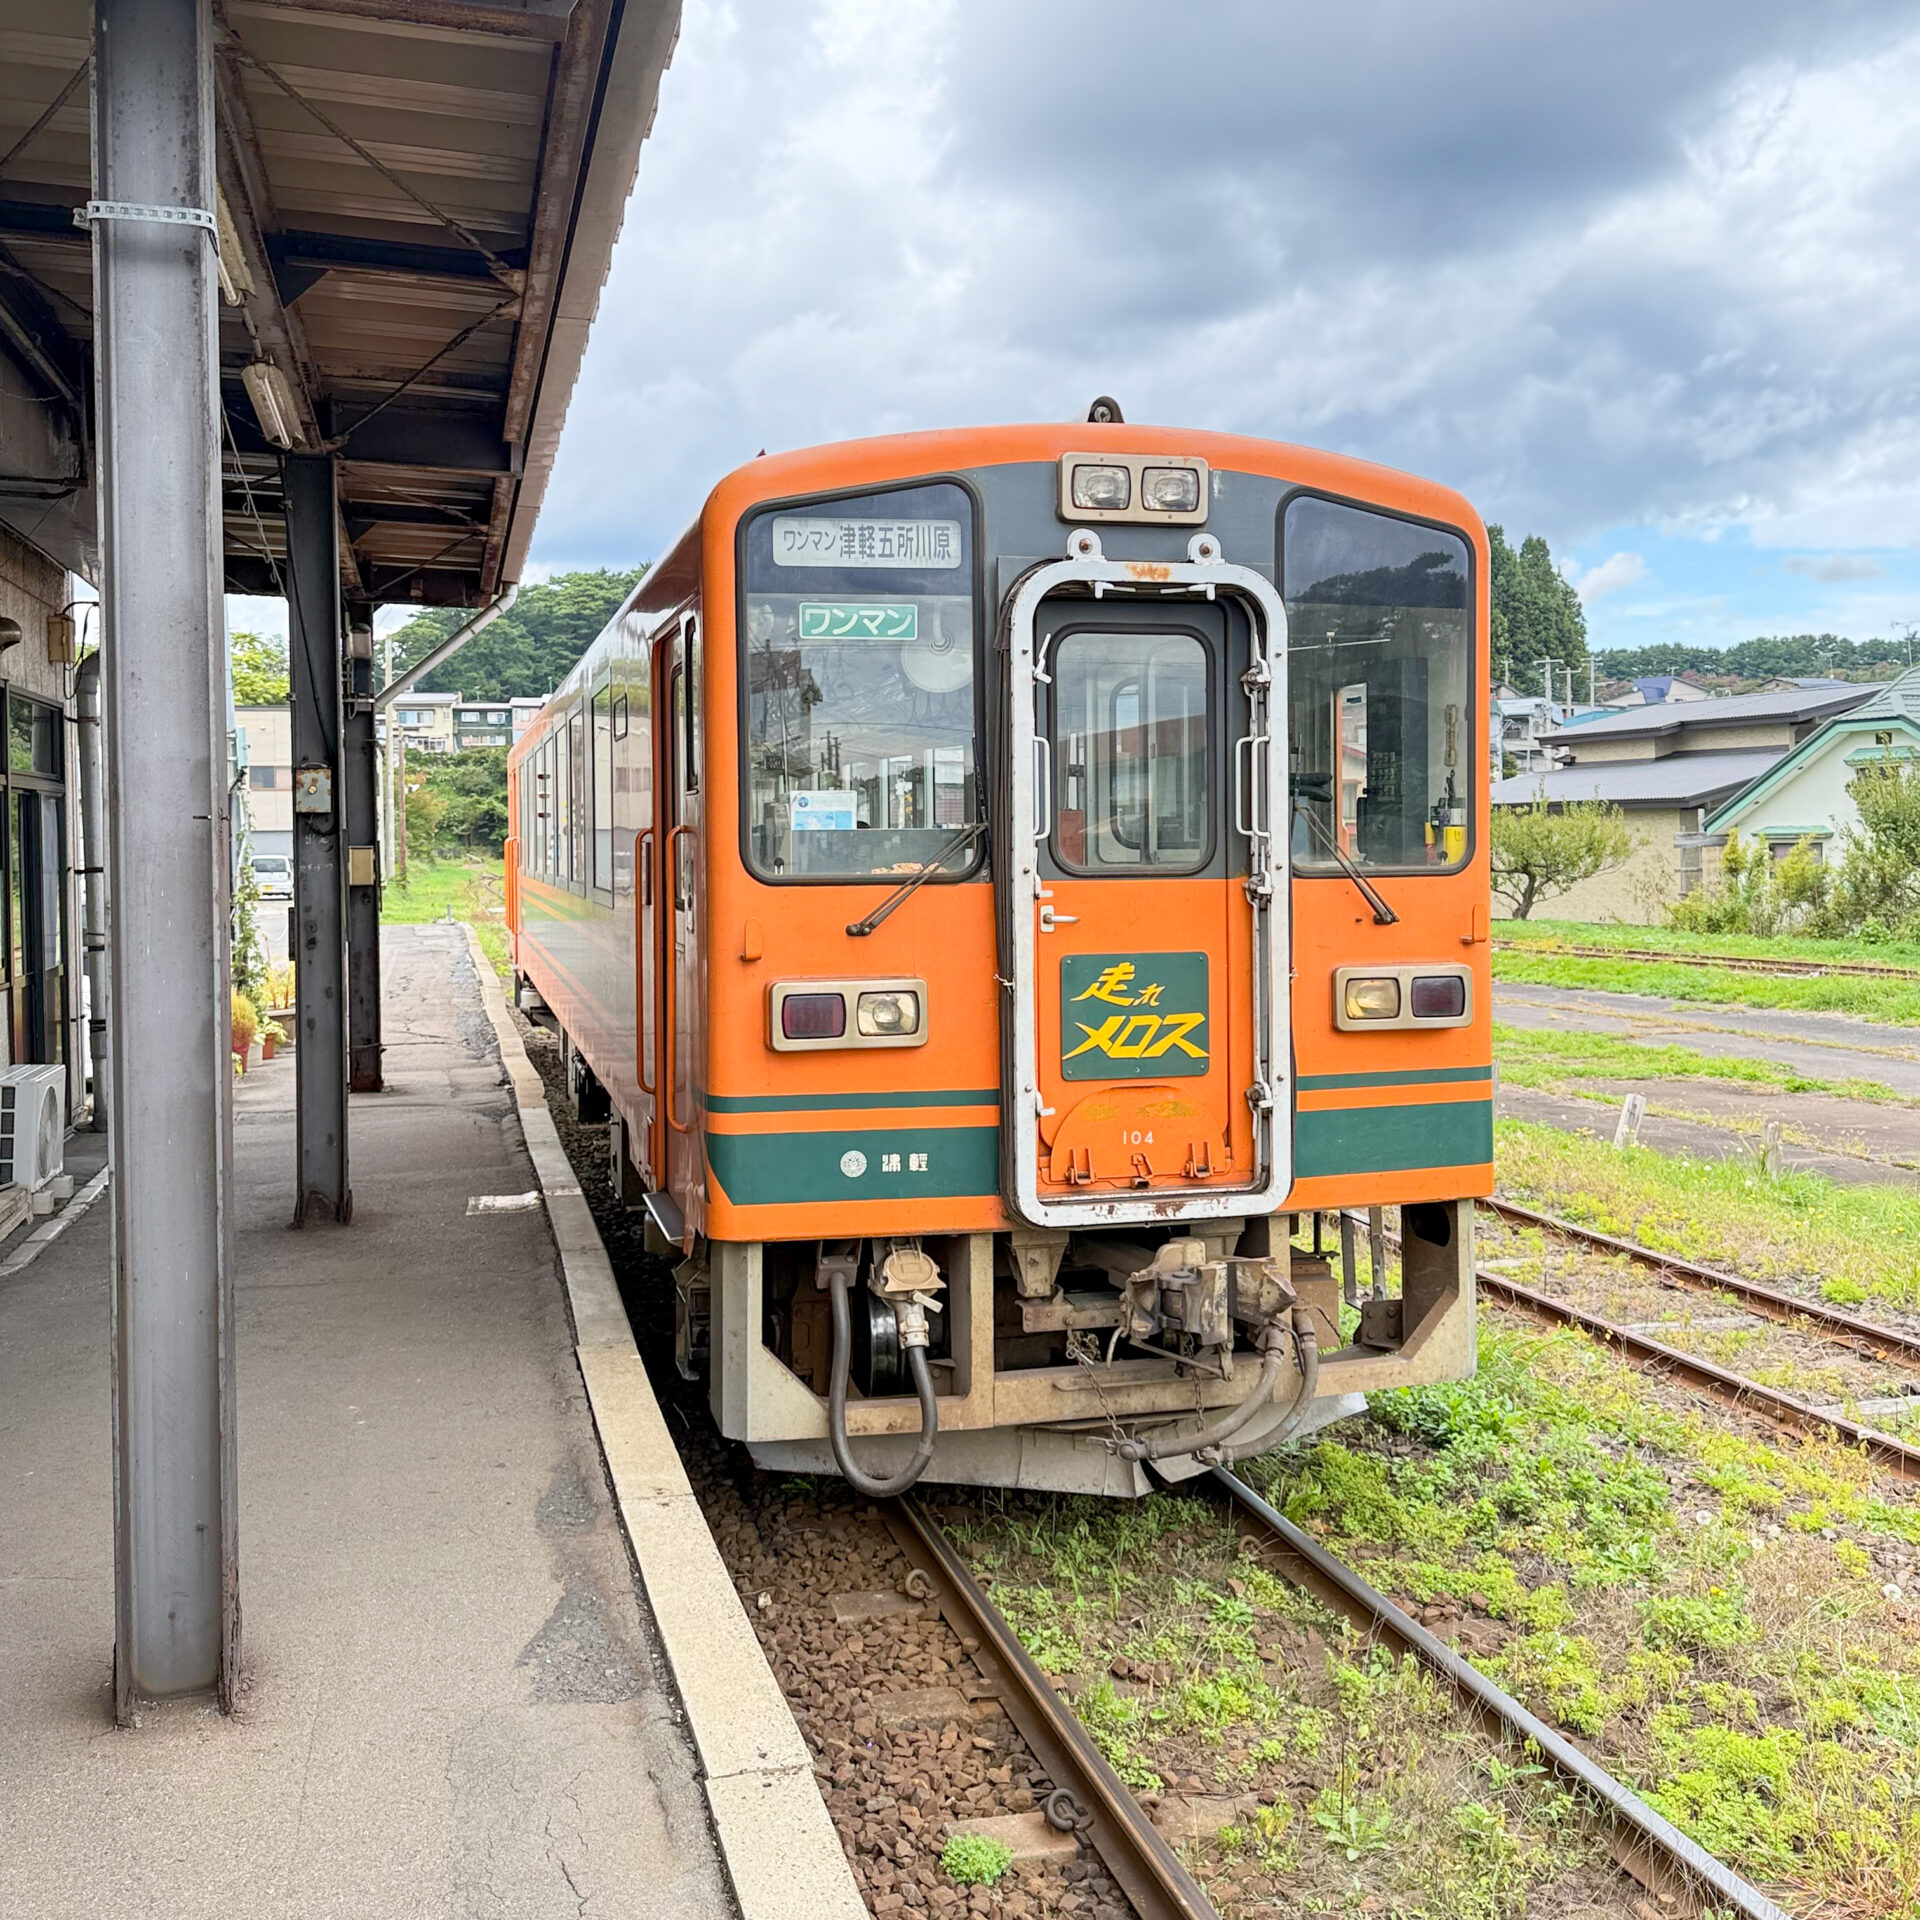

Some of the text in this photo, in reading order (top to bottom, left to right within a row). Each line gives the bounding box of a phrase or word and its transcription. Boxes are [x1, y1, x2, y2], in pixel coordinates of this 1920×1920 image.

[805, 608, 912, 636] ワンマン
[1070, 962, 1165, 1007] 走れ
[1062, 1012, 1210, 1059] メロス
[1122, 1130, 1155, 1145] 104
